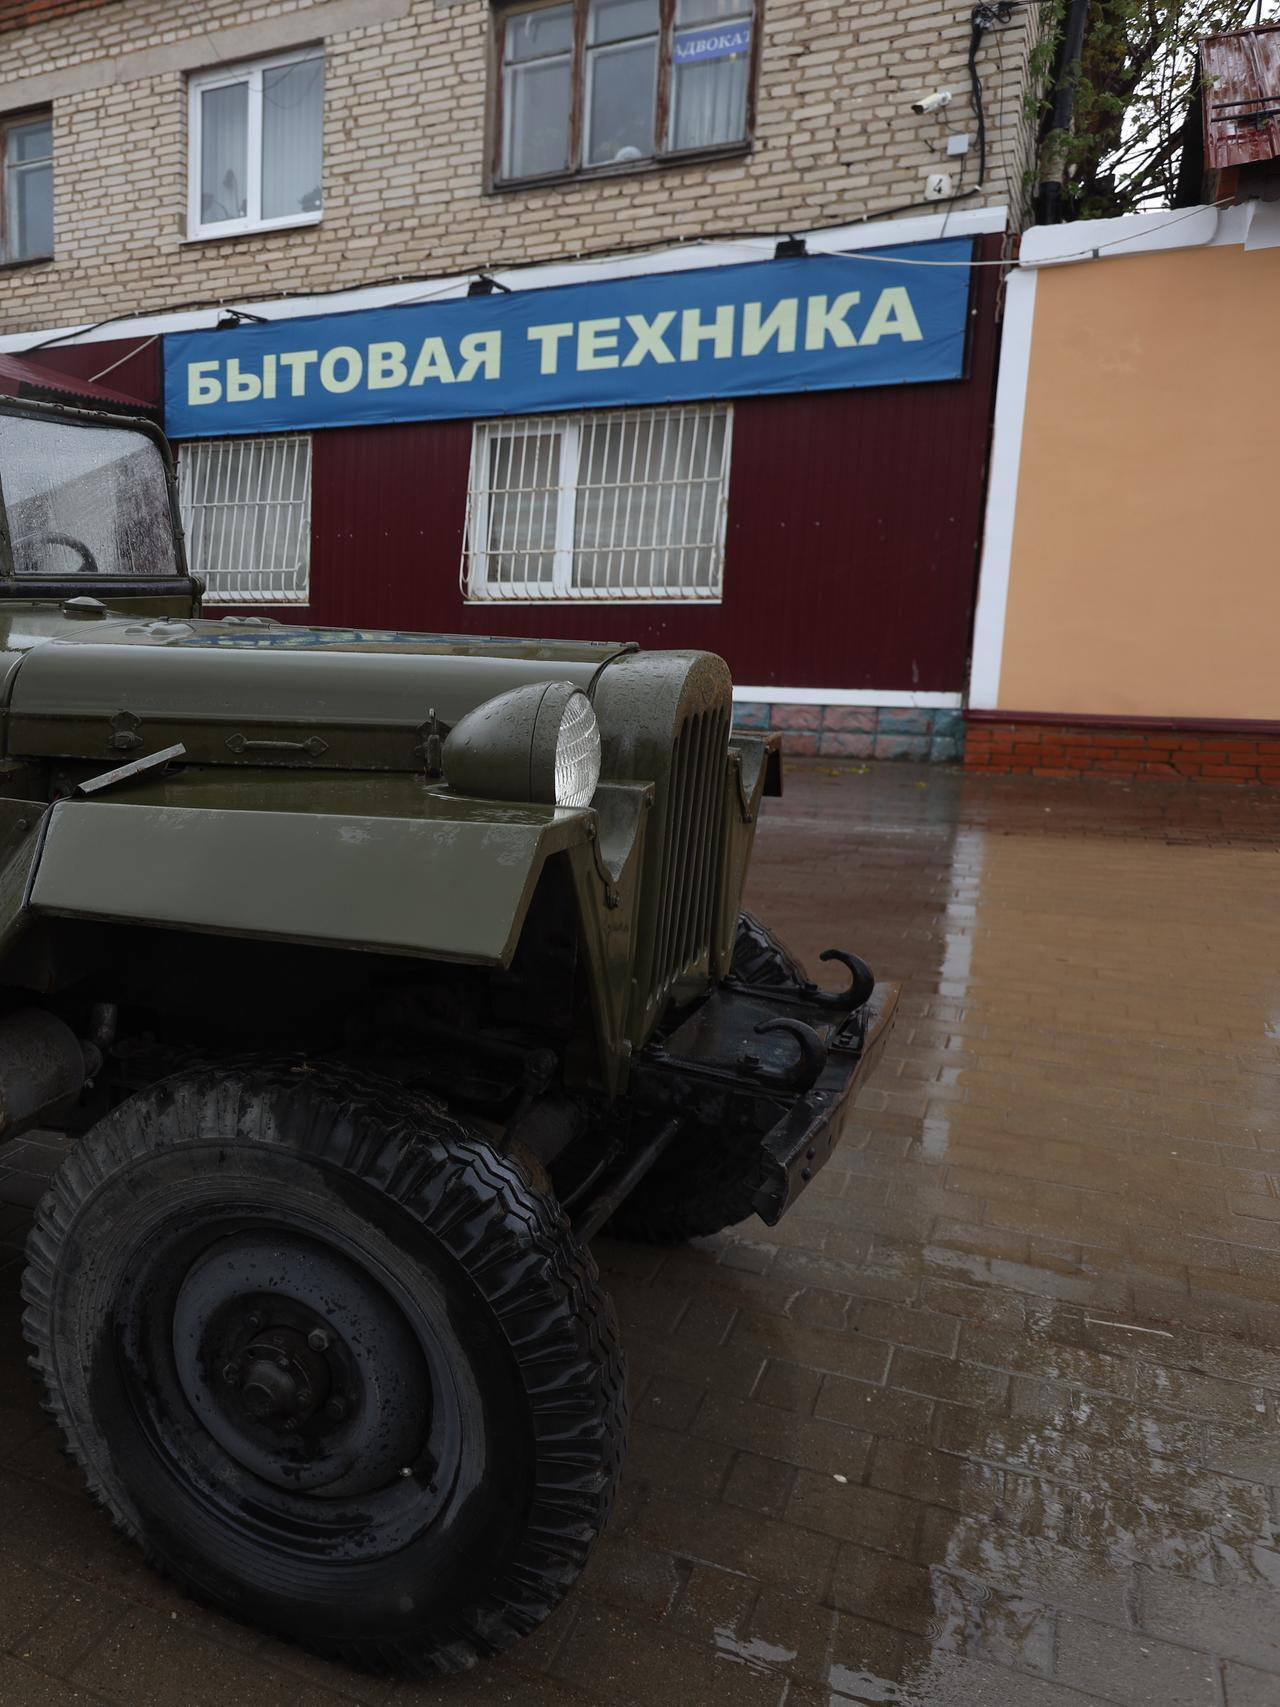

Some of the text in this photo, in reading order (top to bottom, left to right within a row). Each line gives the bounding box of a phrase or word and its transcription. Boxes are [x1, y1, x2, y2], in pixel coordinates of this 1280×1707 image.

[932, 177, 943, 195] 4
[187, 286, 923, 406] БЫТОВАЯ ТЕХНИКА
